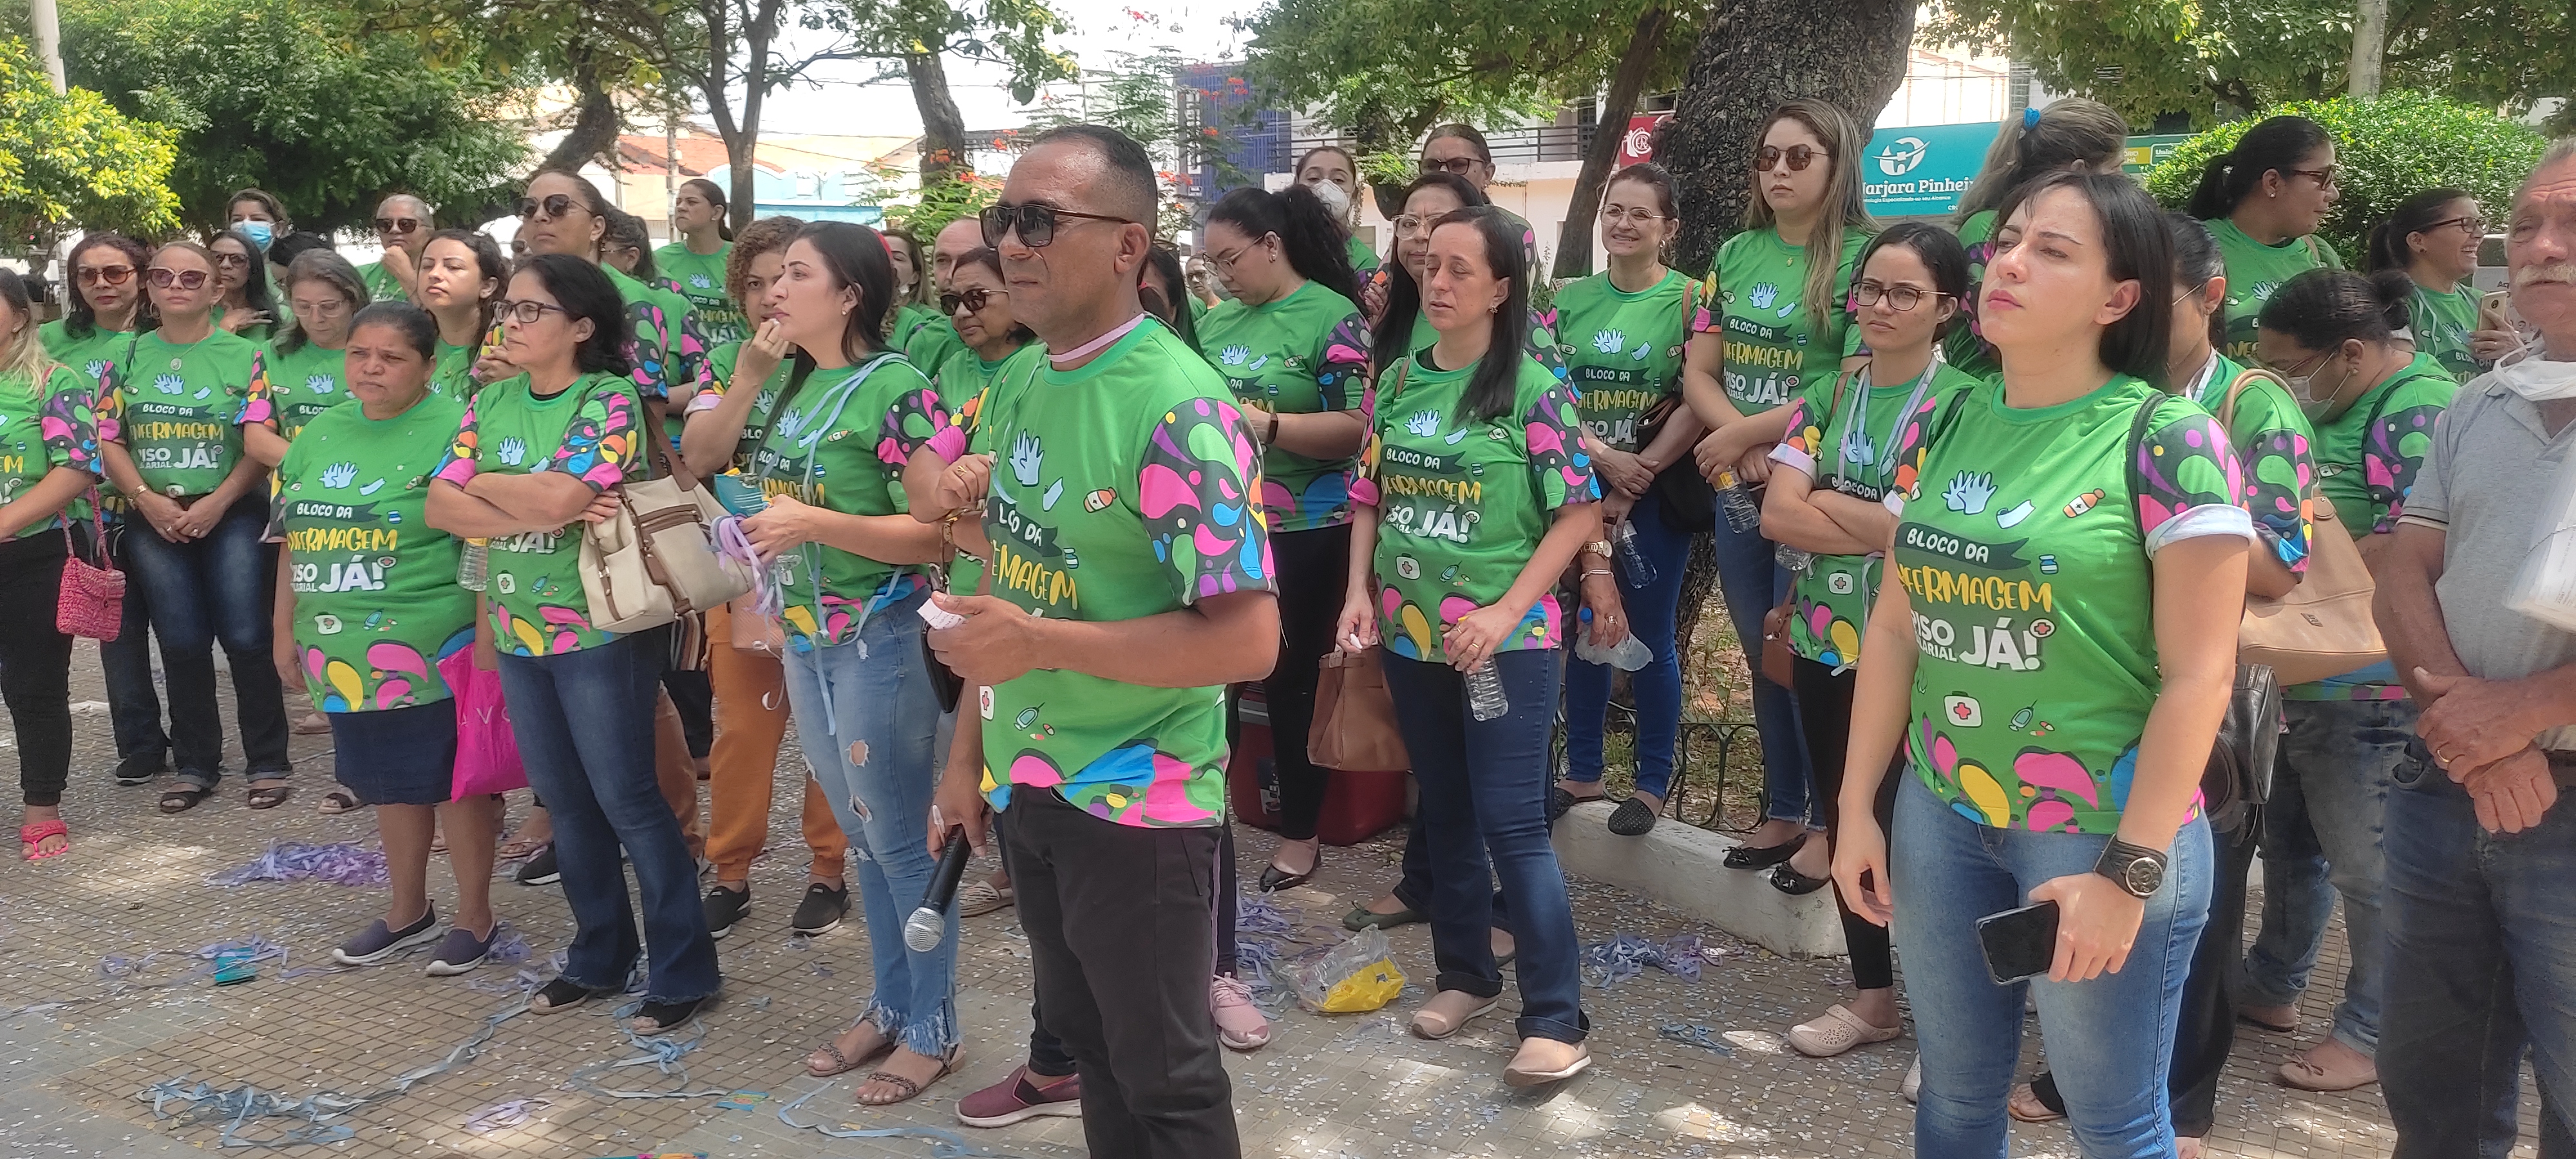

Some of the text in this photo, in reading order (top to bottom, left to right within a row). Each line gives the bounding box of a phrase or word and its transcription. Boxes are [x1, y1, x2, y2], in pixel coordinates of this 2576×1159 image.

[1729, 318, 1773, 339] BLOCO DA
[1723, 340, 1803, 371] NFERMAGEM
[1586, 368, 1631, 382] BLOCO DA
[1746, 372, 1788, 405] JÁ!
[142, 403, 193, 417] BLOCO DA
[741, 428, 763, 439] BLO
[1386, 448, 1441, 470] BLOCO DA
[1831, 476, 1877, 500] BOCO DA
[296, 502, 353, 519] BLOCO DA
[1024, 523, 1042, 547] DA
[1412, 504, 1468, 543] JÁ!
[1906, 528, 1989, 563] BLOCO DA
[319, 554, 386, 593] JÁ!
[1897, 563, 2052, 613] NFERMAGEM
[1958, 616, 2041, 670] JÁ!
